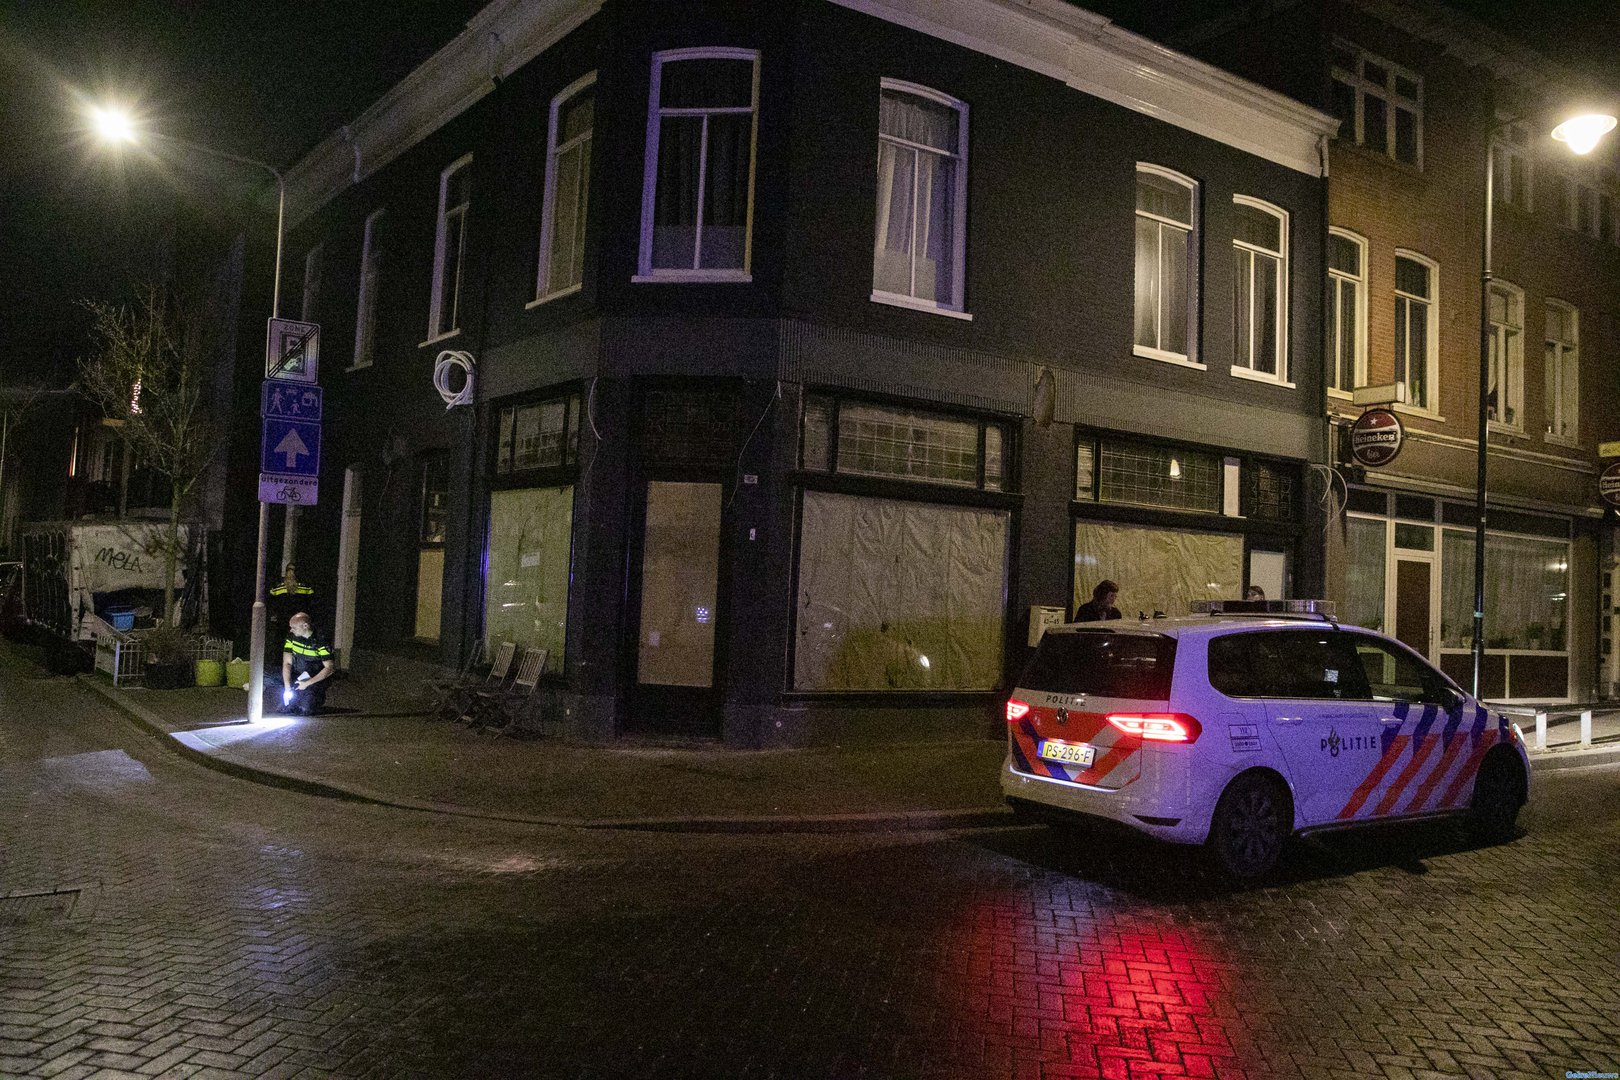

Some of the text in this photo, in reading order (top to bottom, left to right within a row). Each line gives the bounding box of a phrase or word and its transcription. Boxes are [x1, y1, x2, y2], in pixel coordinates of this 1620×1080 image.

[1355, 433, 1395, 444] Heineken
[1045, 744, 1091, 763] PS-296-F
[1320, 736, 1377, 757] POLITIE
